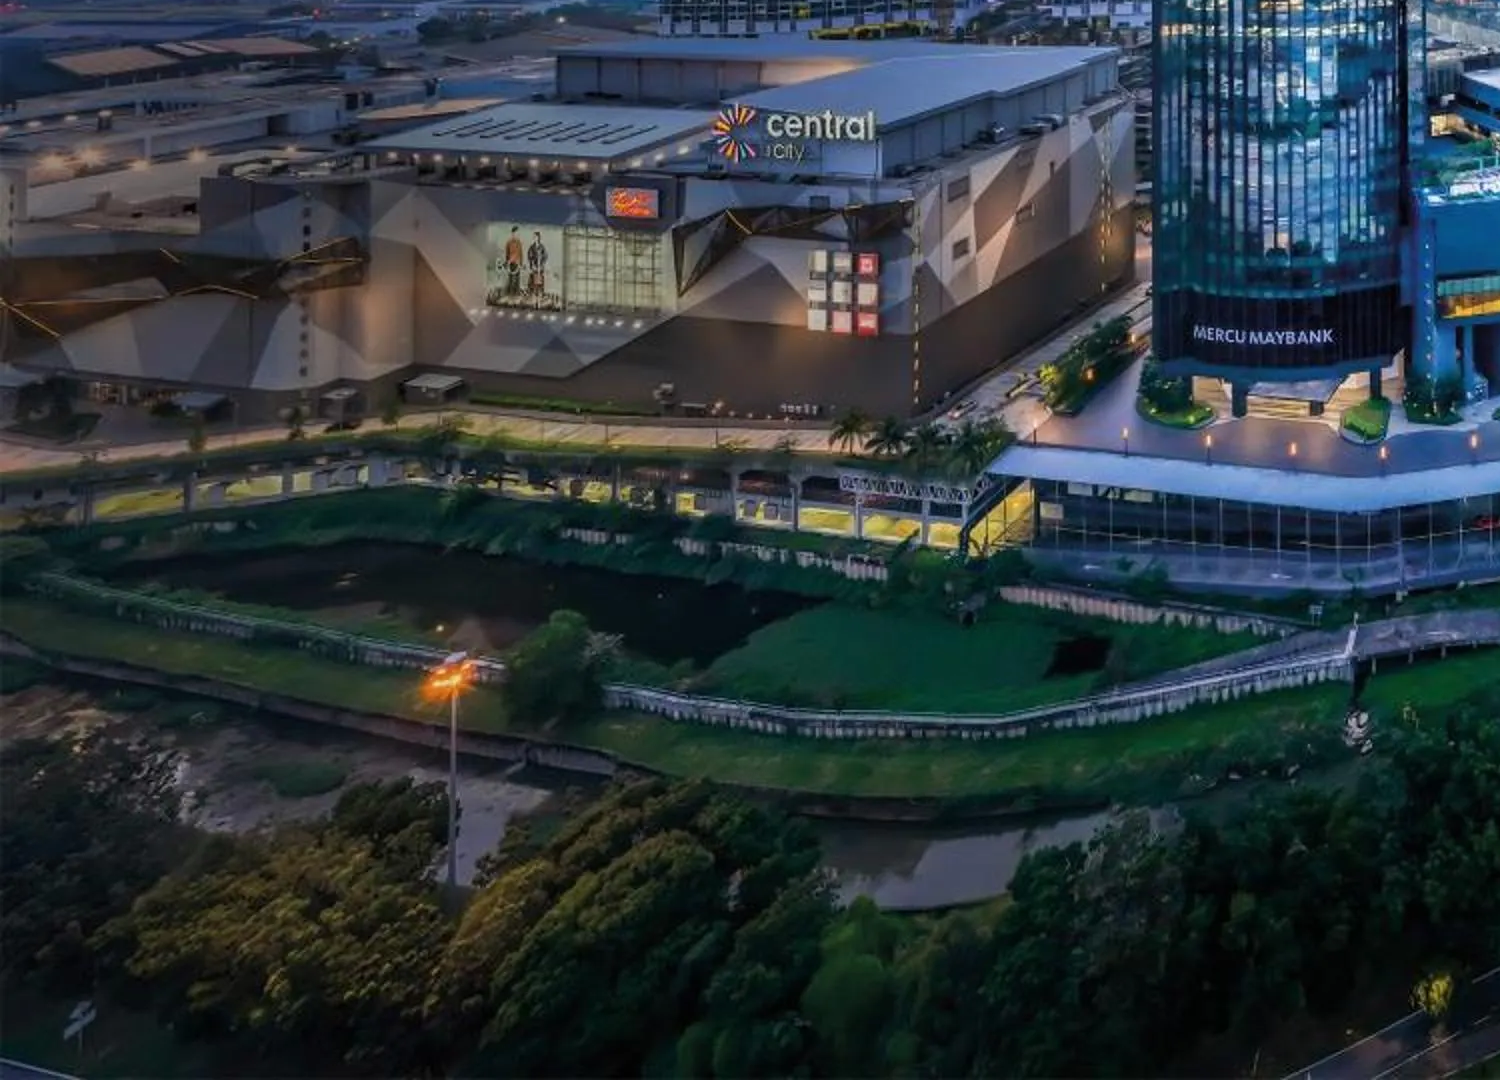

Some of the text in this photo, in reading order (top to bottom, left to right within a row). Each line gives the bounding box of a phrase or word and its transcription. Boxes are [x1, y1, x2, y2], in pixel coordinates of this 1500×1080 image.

[767, 109, 874, 140] central
[1193, 325, 1334, 345] MERCU MAYBANK
